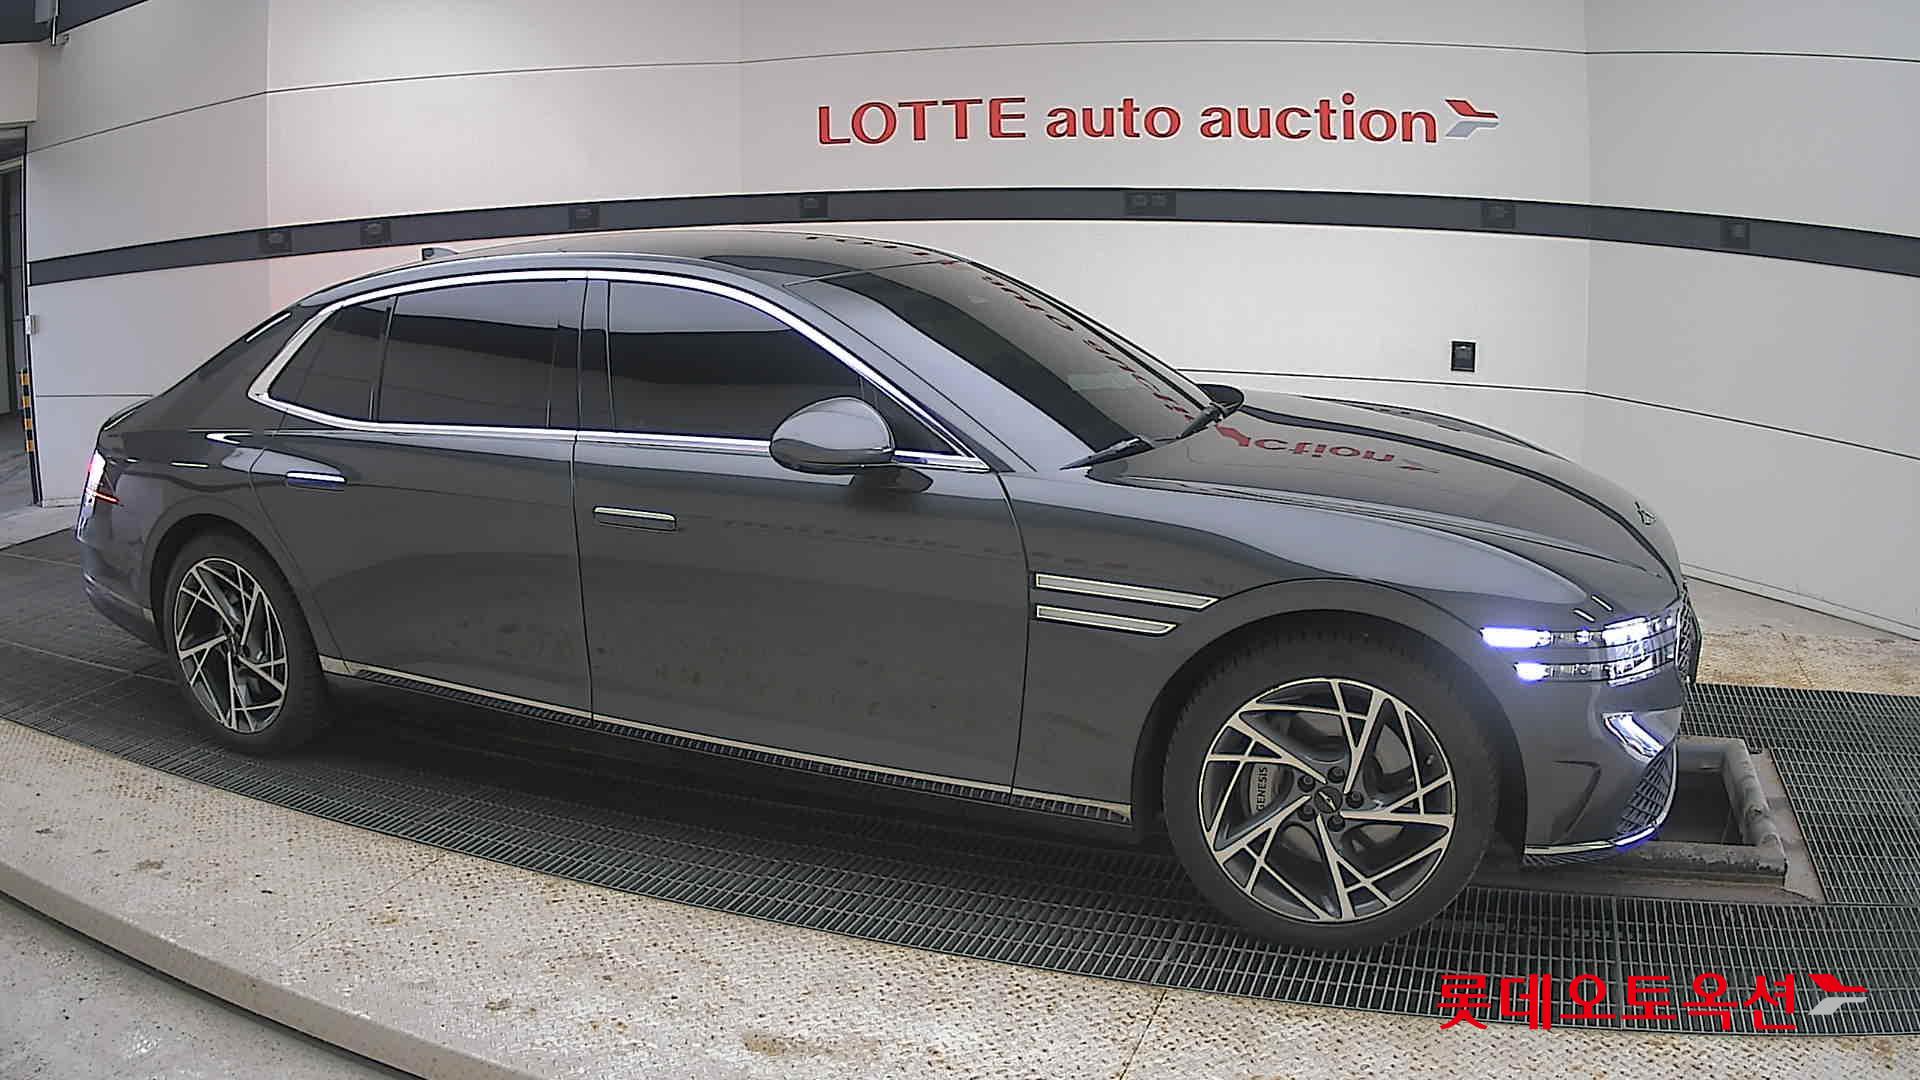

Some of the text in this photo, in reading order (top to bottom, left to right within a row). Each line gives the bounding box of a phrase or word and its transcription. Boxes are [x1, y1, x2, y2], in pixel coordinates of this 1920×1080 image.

[818, 93, 1437, 144] LOTTE auto auction
[1256, 767, 1268, 811] GENESIS
